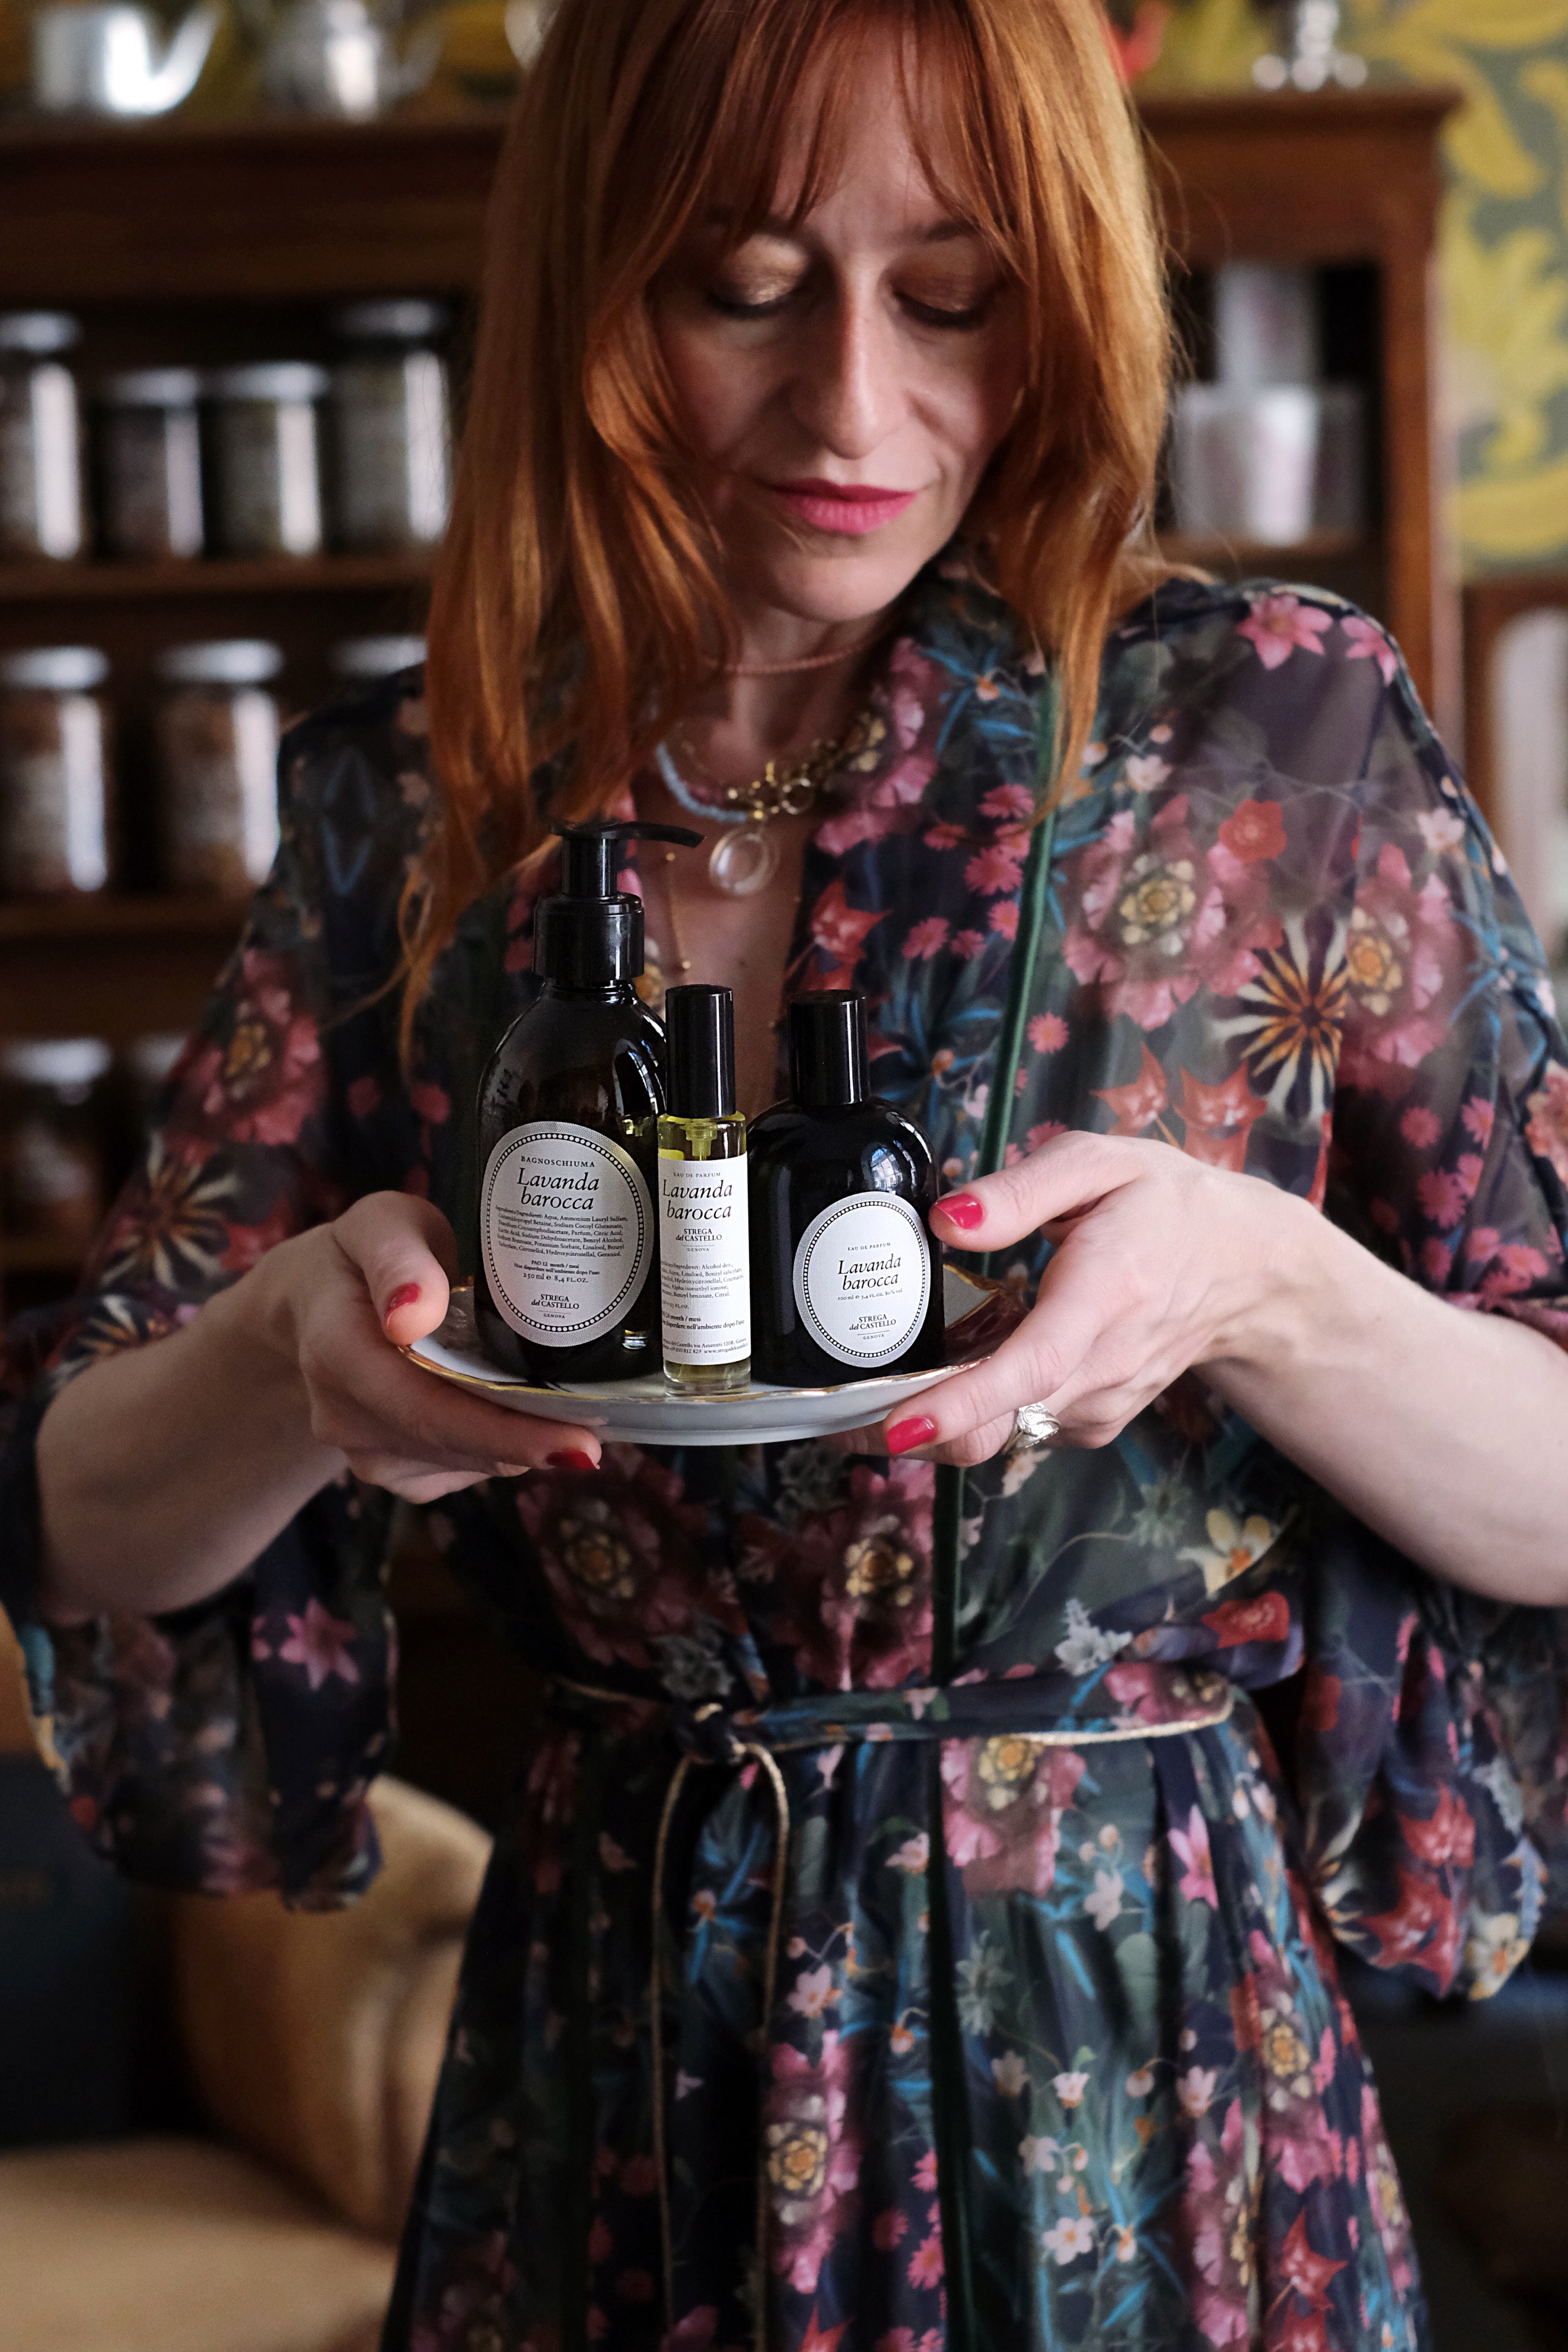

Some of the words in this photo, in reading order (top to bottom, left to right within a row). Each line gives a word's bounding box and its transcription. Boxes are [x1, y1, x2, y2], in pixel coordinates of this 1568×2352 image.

[521, 1156, 595, 1167] BAGNOSCHIUMA
[517, 1167, 599, 1191] Lavanda
[662, 1179, 733, 1199] Lavanda
[521, 1186, 594, 1209] barocca
[667, 1200, 732, 1220] barocca
[838, 1253, 901, 1274] Lavanda
[843, 1274, 898, 1290] barocca
[540, 1294, 570, 1302] STREGA
[541, 1300, 580, 1309] CASTELLO
[859, 1313, 887, 1323] STREGA
[860, 1319, 896, 1329] CASTELLO
